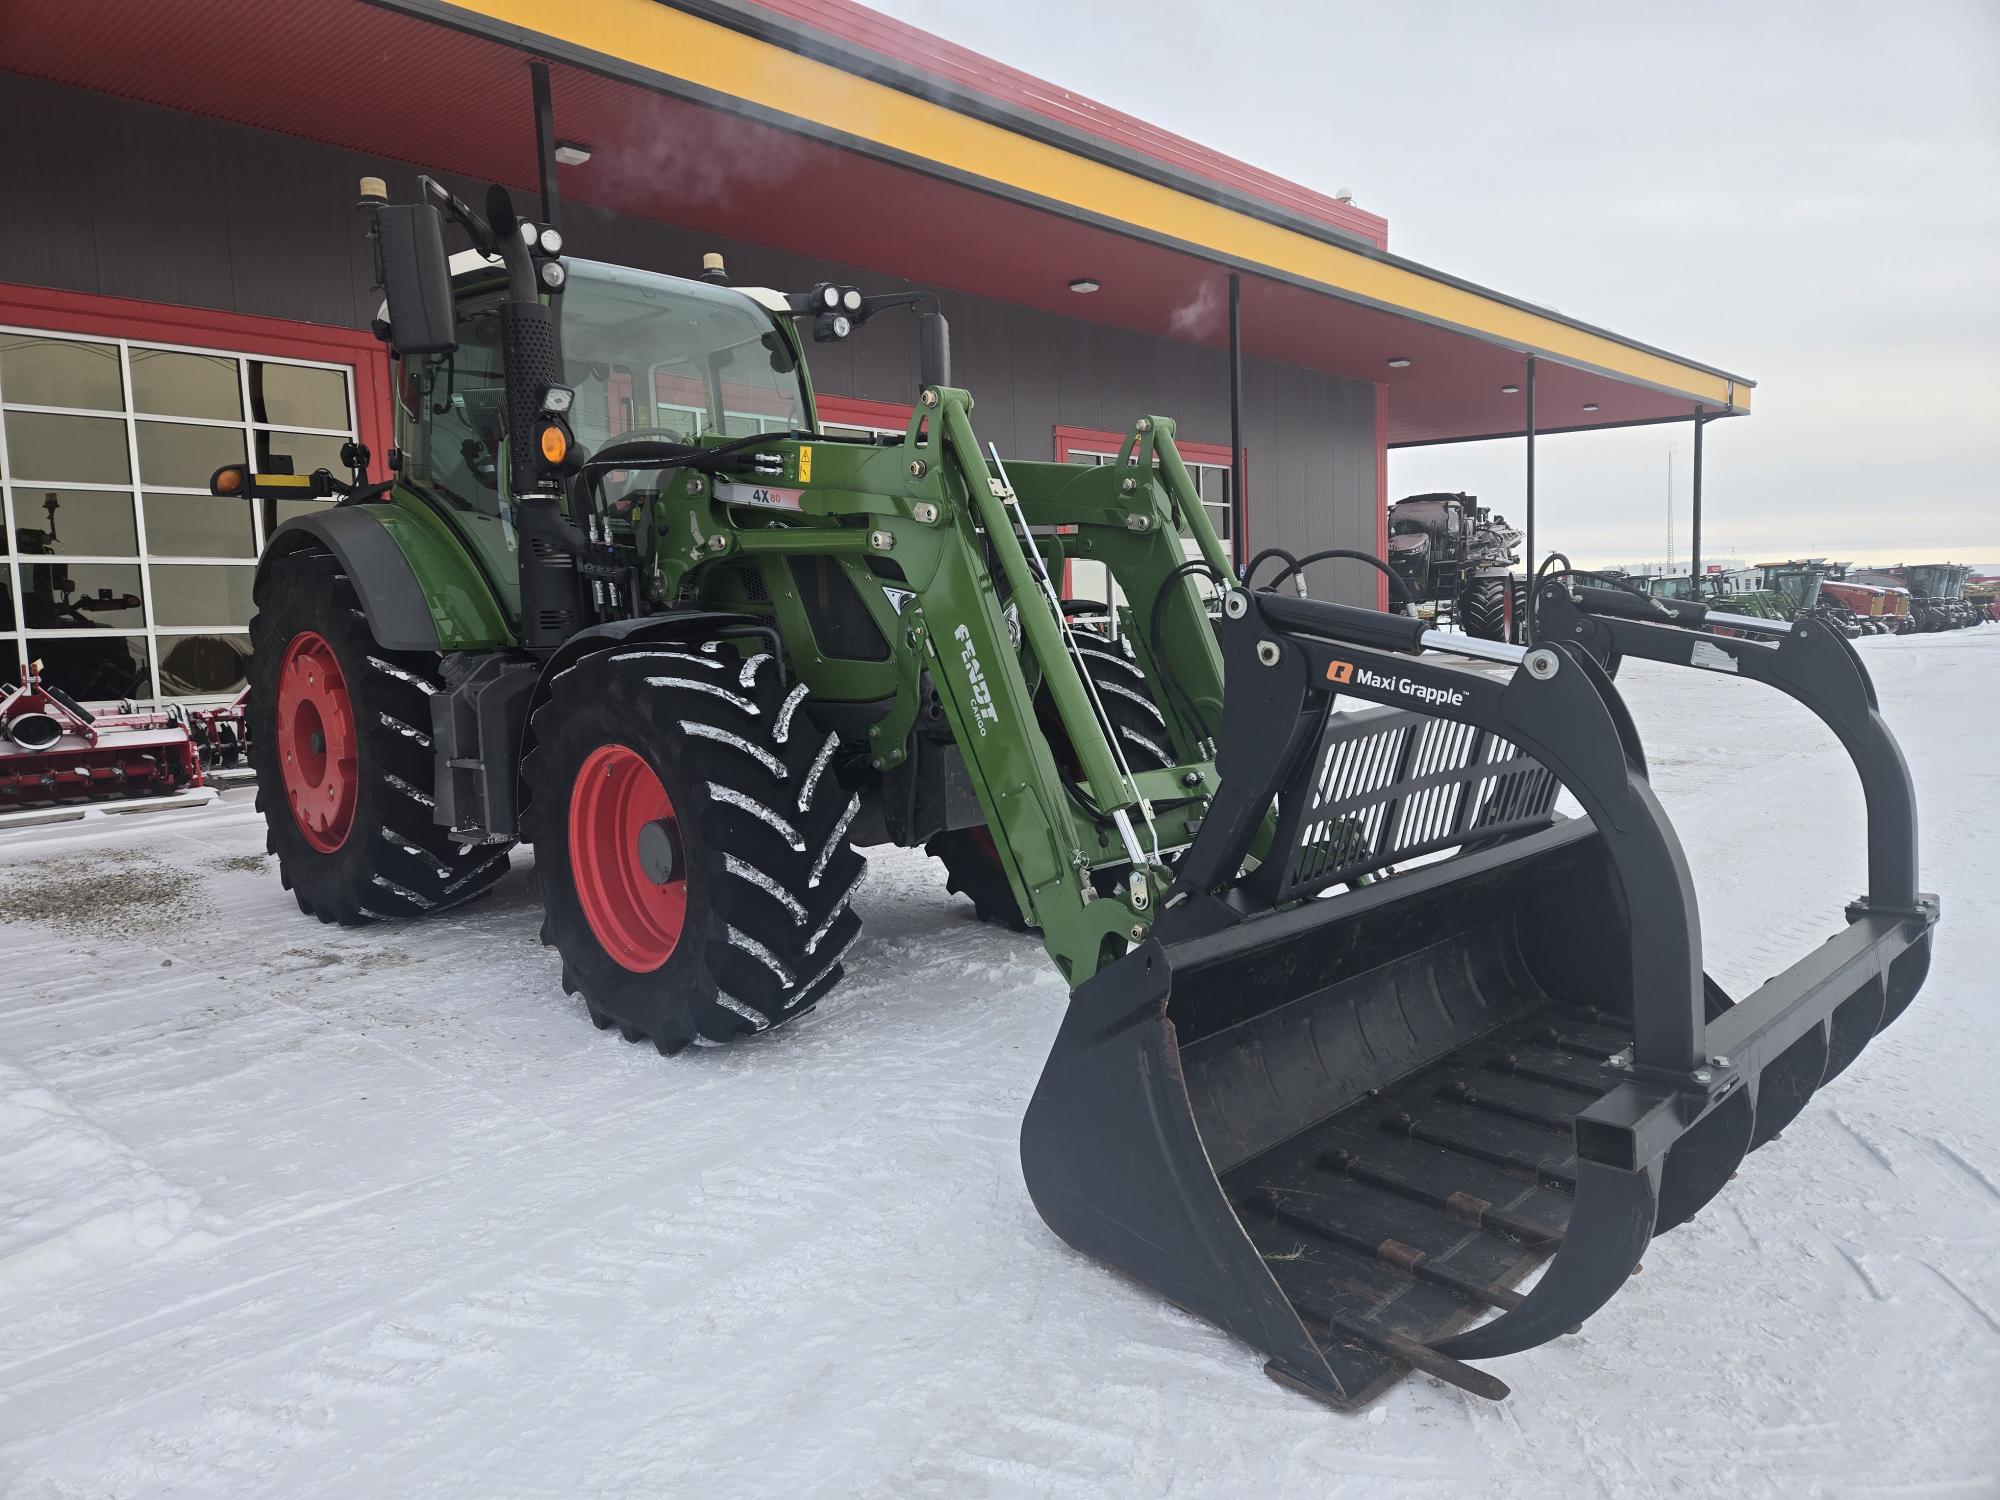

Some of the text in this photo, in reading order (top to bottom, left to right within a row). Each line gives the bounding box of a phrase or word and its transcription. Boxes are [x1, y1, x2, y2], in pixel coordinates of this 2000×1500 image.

[954, 624, 999, 723] FENDT
[1357, 668, 1396, 691] Maxi
[970, 698, 987, 737] CARGO
